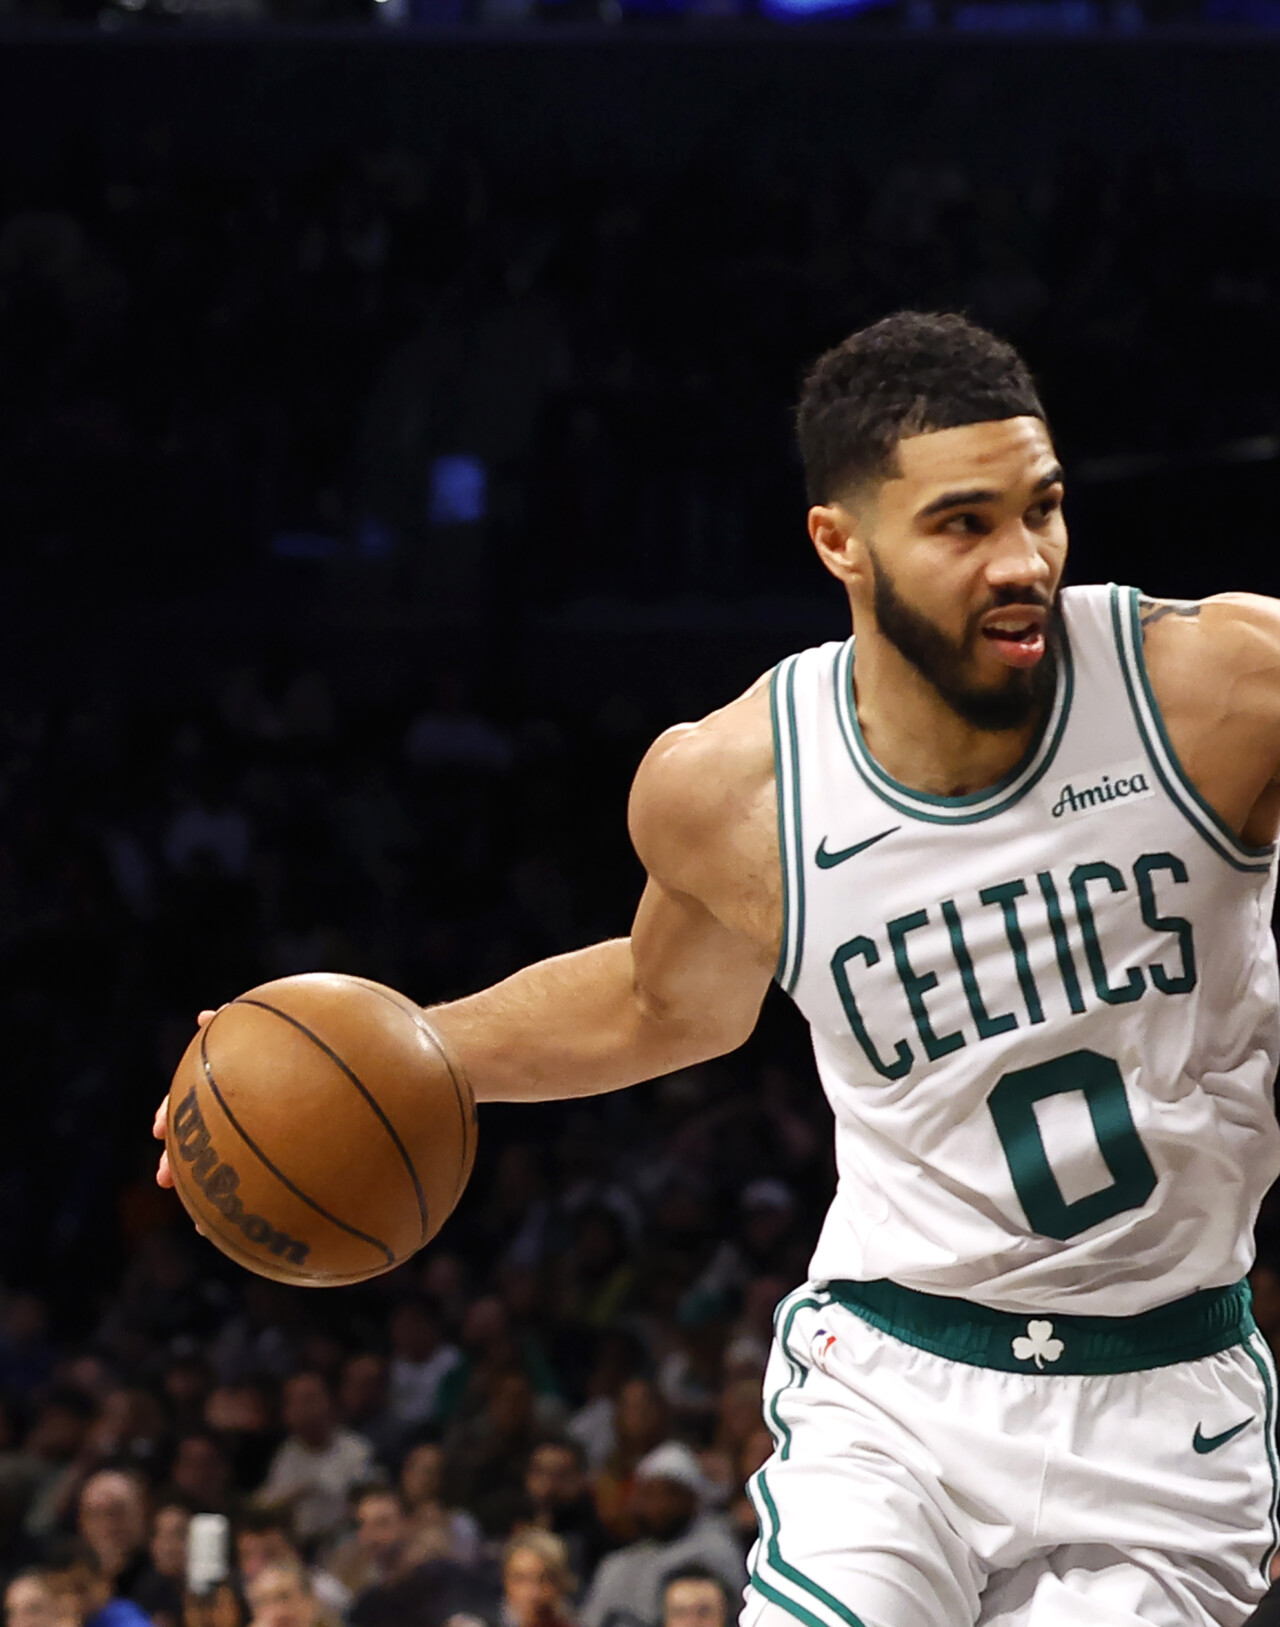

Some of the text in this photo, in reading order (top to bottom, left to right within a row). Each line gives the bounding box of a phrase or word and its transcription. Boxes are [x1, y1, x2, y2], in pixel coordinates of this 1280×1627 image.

[1052, 773, 1149, 818] Amica
[830, 853, 1197, 1081] CELTICS
[173, 1084, 312, 1266] Wilson
[986, 1048, 1158, 1241] 0
